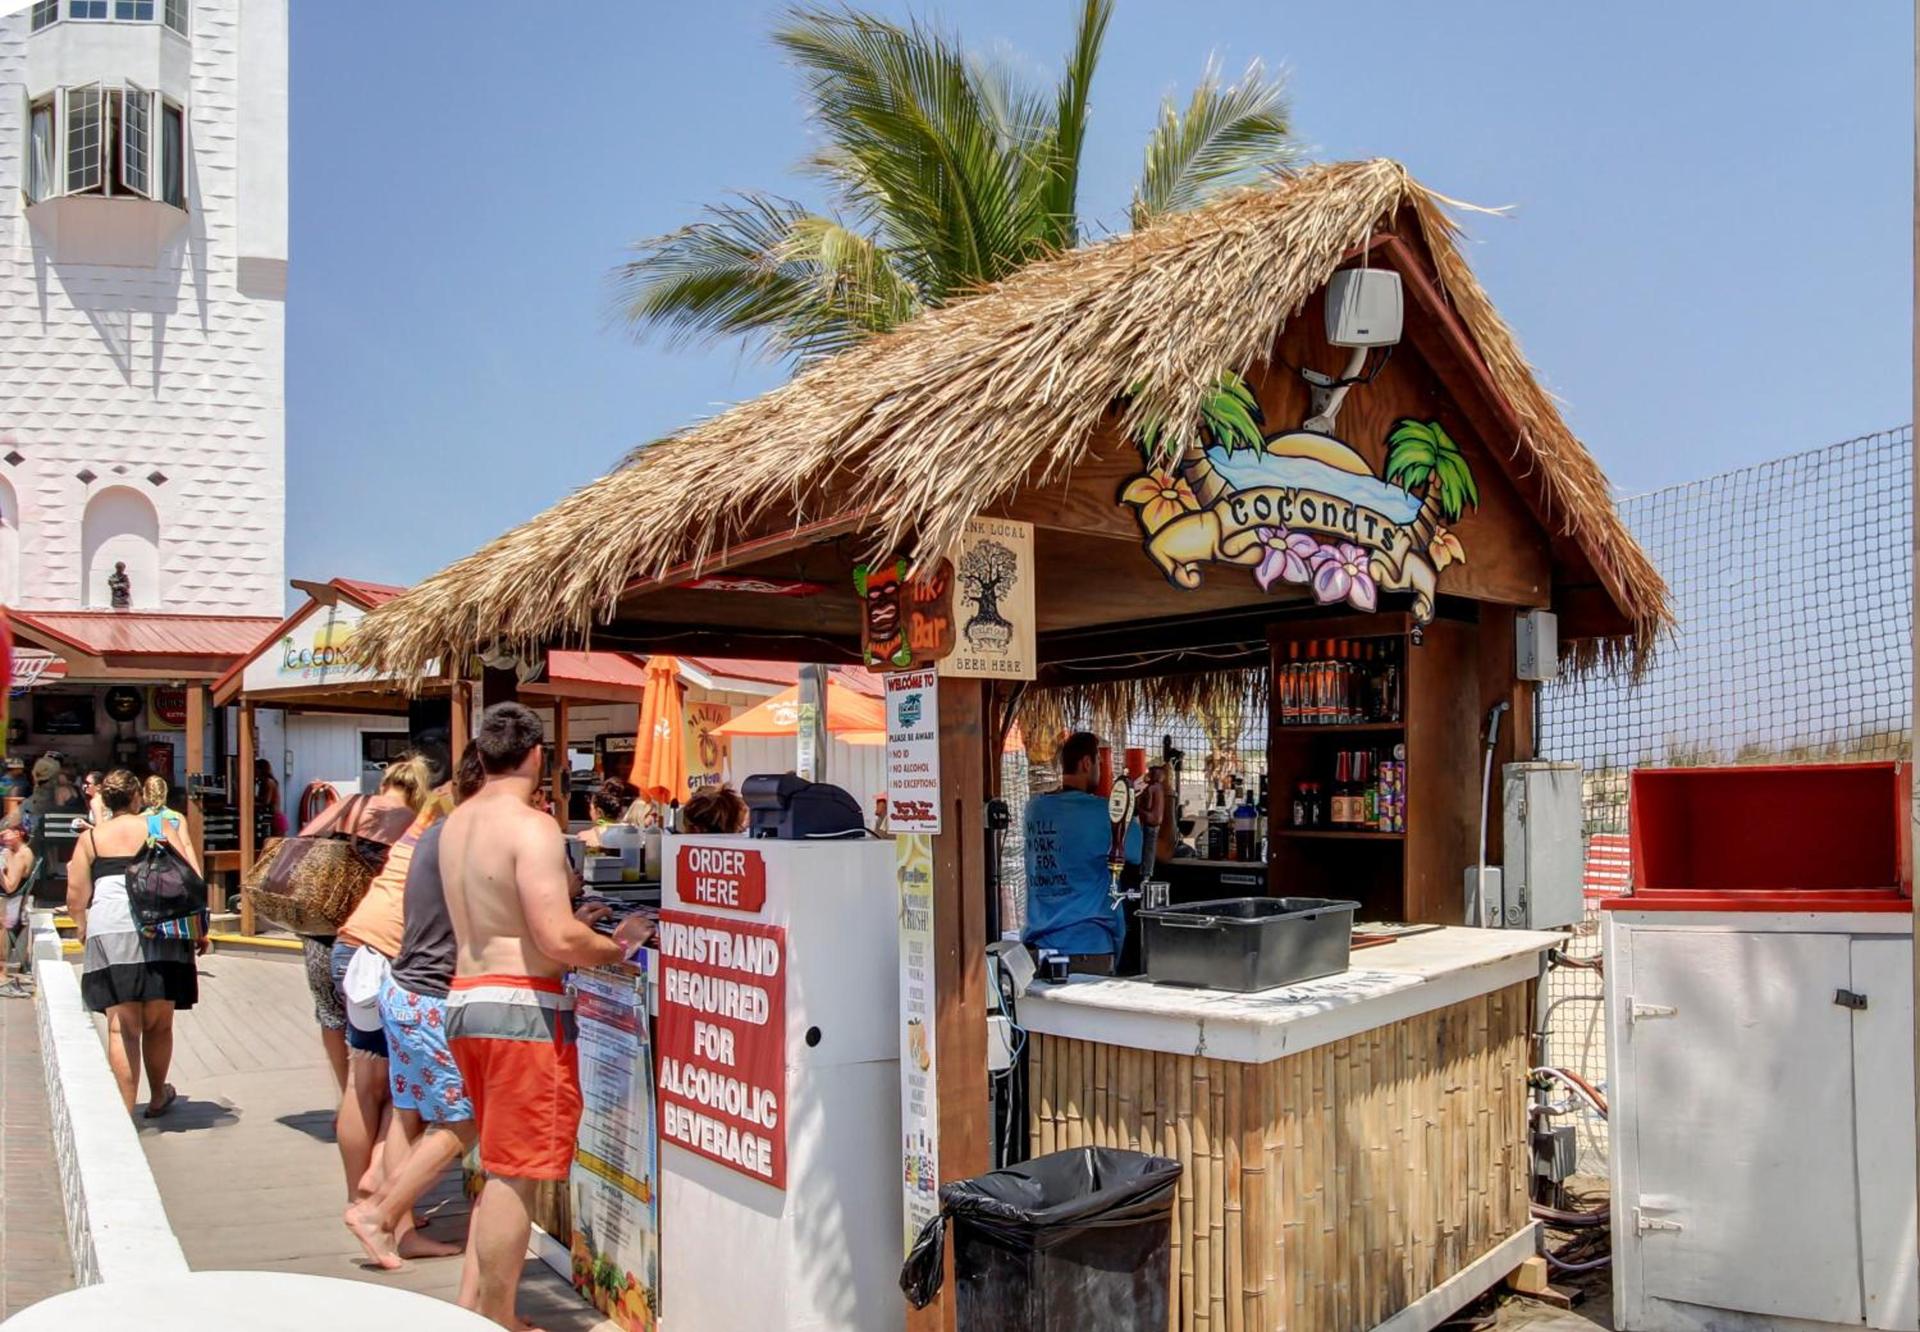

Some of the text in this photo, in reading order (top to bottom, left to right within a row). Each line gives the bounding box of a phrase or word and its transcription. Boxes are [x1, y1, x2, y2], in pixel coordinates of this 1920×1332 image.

[991, 523, 1026, 539] LOCAL
[911, 612, 948, 650] Bar
[956, 657, 1022, 673] BEER HERE
[888, 673, 934, 692] WELCOME TO
[889, 733, 907, 743] PLEASE
[915, 731, 934, 741] AWARE
[892, 750, 902, 759] NO
[893, 762, 929, 773] NO ALCOHOL
[687, 776, 702, 789] GET
[893, 778, 937, 789] NO EXCEPTIONS
[1026, 820, 1057, 835] WILL
[688, 848, 746, 876] ORDER
[1036, 855, 1058, 870] FOR
[695, 877, 740, 906] HERE
[658, 920, 780, 977] WRISTBAND
[665, 966, 769, 1025] REQUIRED
[694, 1020, 736, 1066] FOR
[659, 1056, 778, 1129] ALCOHOLIC
[664, 1101, 773, 1178] BEVERAGE
